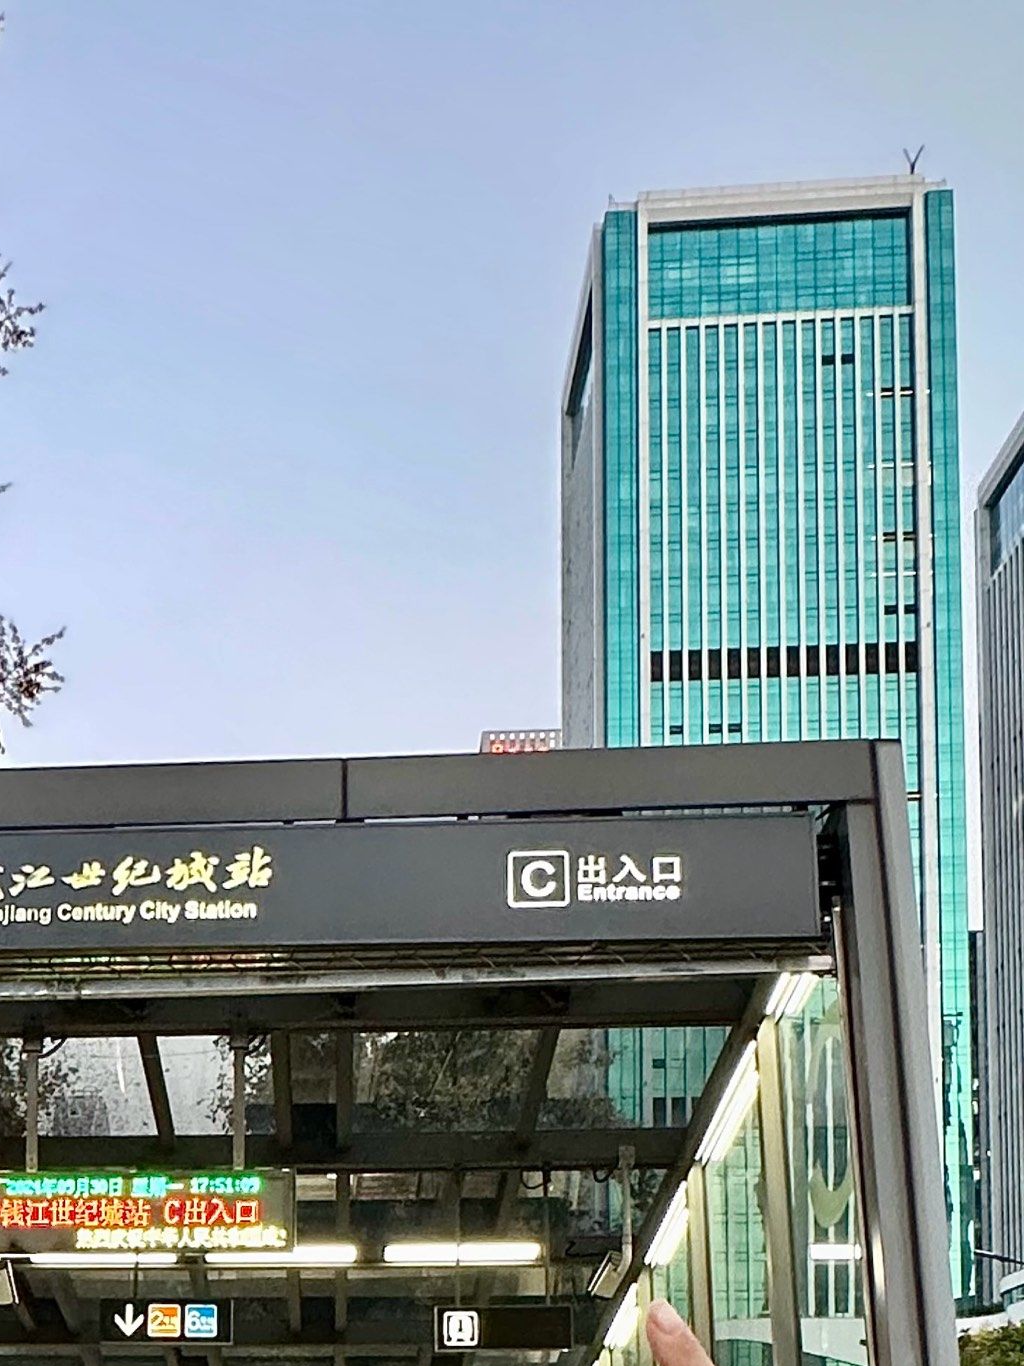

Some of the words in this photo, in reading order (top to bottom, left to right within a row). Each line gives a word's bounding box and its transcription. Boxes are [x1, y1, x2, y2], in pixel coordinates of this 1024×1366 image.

[520, 860, 557, 898] C
[577, 854, 681, 884] 出入口
[577, 883, 681, 902] Entrance
[57, 901, 137, 925] Century
[139, 900, 181, 925] City
[184, 900, 257, 920] Station
[0, 1199, 151, 1227] 钱江世纪城站
